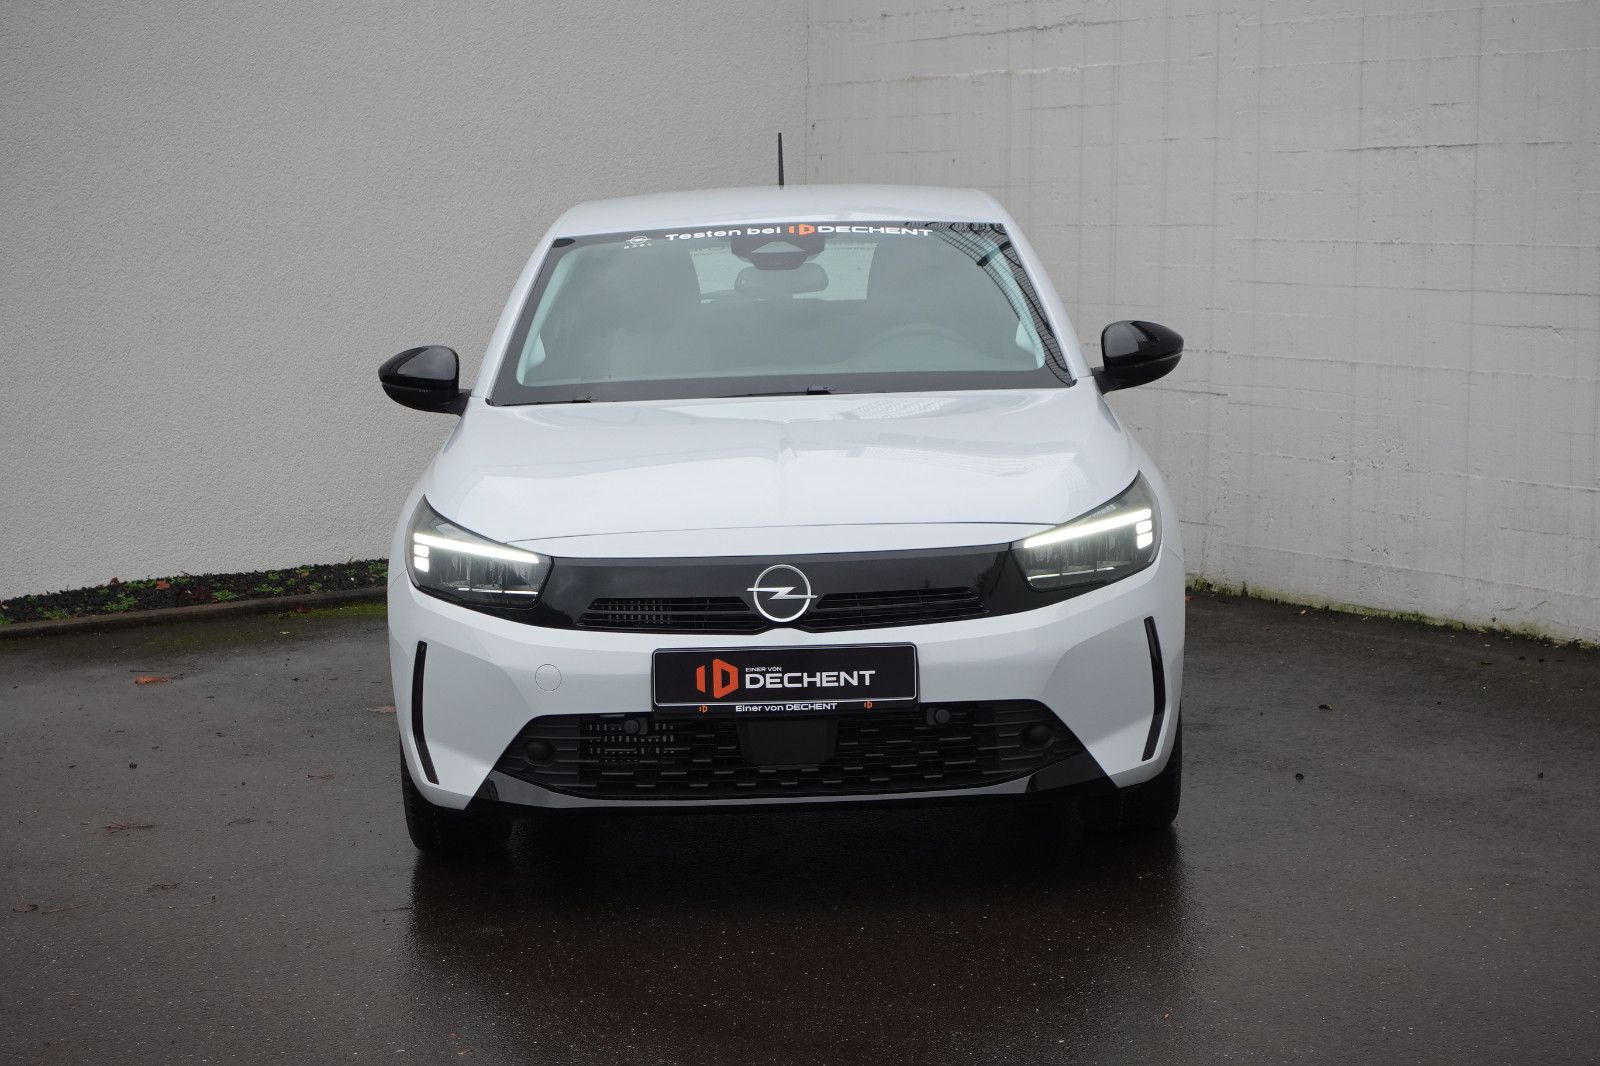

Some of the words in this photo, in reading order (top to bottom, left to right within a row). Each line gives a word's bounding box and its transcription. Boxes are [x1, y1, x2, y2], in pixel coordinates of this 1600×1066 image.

[665, 228, 742, 241] Testen
[747, 226, 781, 235] bei
[817, 225, 933, 237] DECHENT
[745, 670, 876, 689] DECHENT
[735, 704, 763, 712] Einer
[764, 704, 784, 712] von
[785, 702, 838, 711] DECHENT
